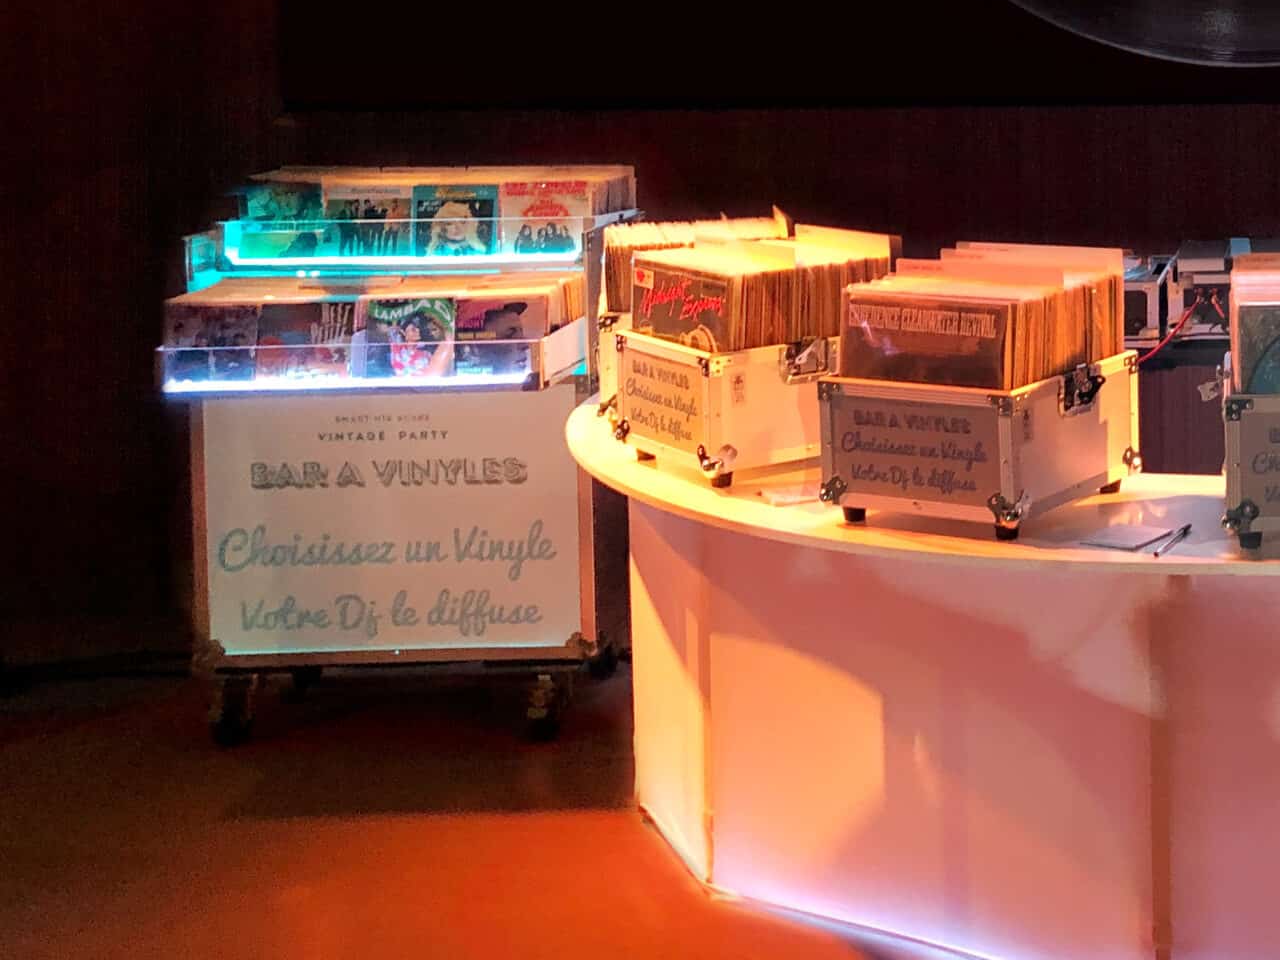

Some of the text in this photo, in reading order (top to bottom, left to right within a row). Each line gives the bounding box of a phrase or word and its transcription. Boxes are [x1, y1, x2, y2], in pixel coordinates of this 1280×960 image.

[318, 430, 448, 441] VINTAGE PARTY
[250, 456, 529, 490] BAR A VINYLES
[217, 519, 557, 582] Choisissez un Vinyle
[241, 588, 544, 638] Votre Dj le diffuse
